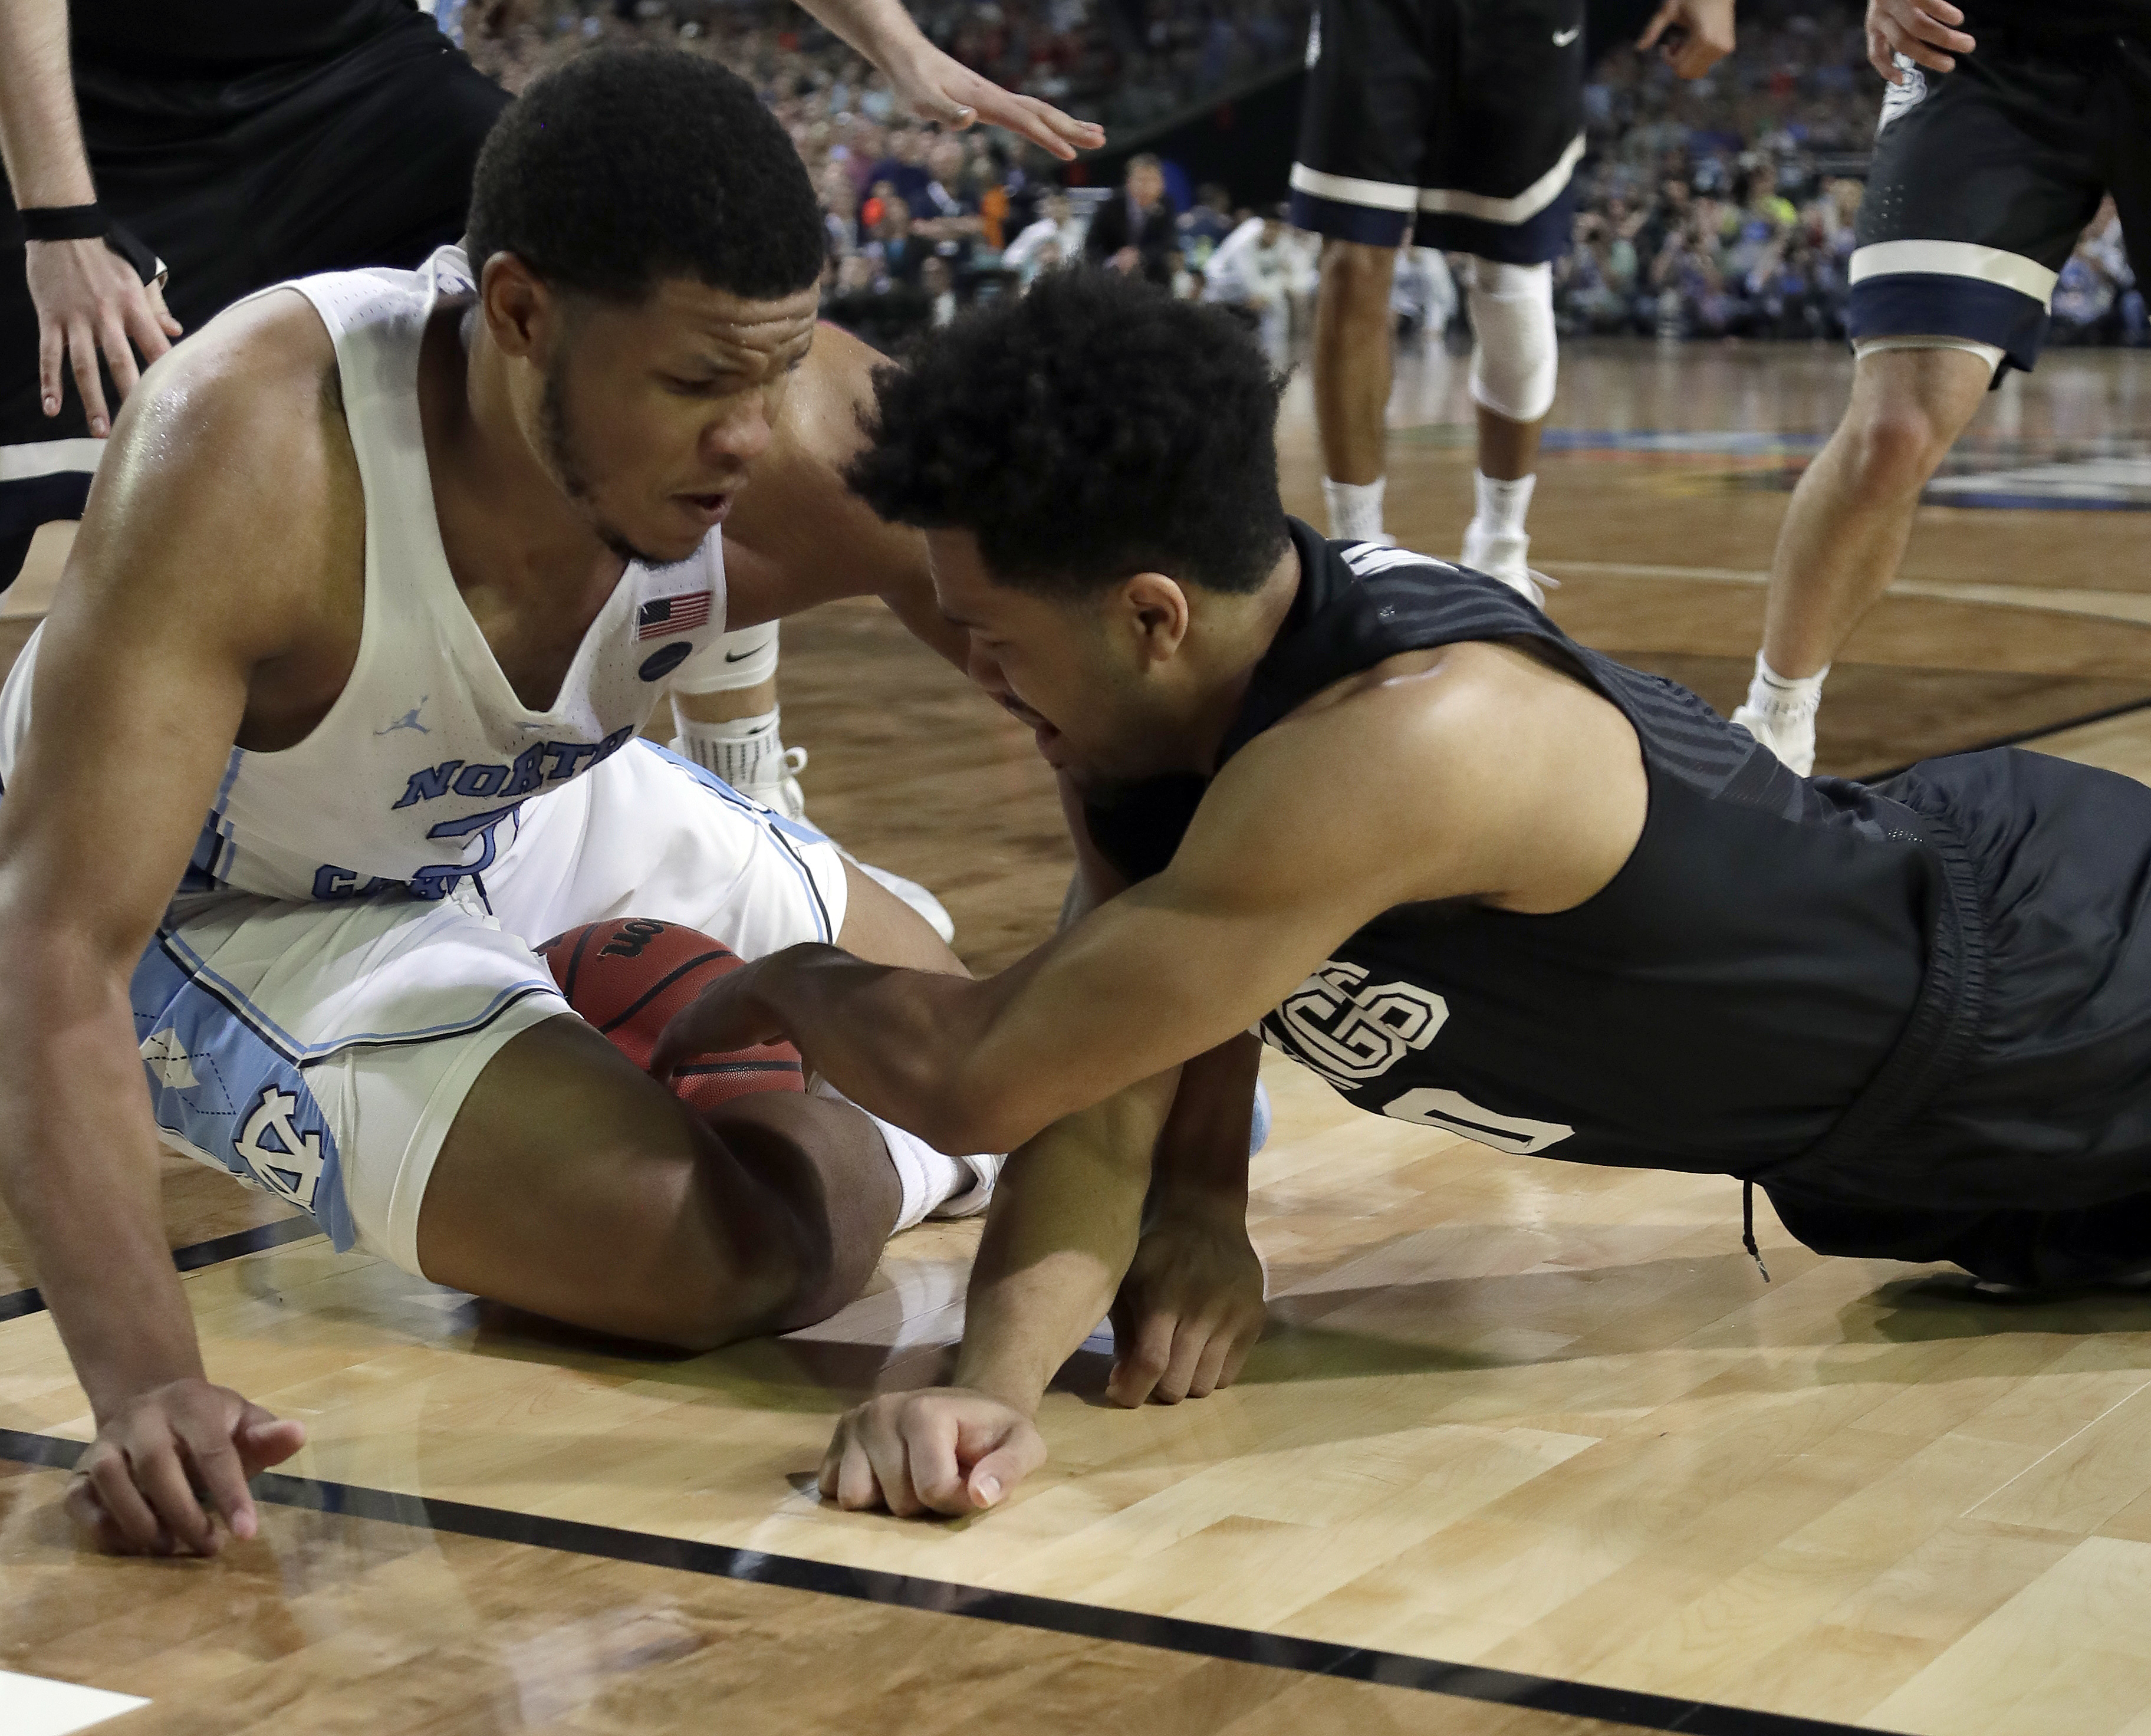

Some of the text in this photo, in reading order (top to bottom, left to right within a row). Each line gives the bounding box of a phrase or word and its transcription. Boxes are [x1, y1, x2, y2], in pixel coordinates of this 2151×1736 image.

[391, 724, 635, 810] NORTH
[597, 920, 666, 958] on
[1382, 1087, 1576, 1155] 0
